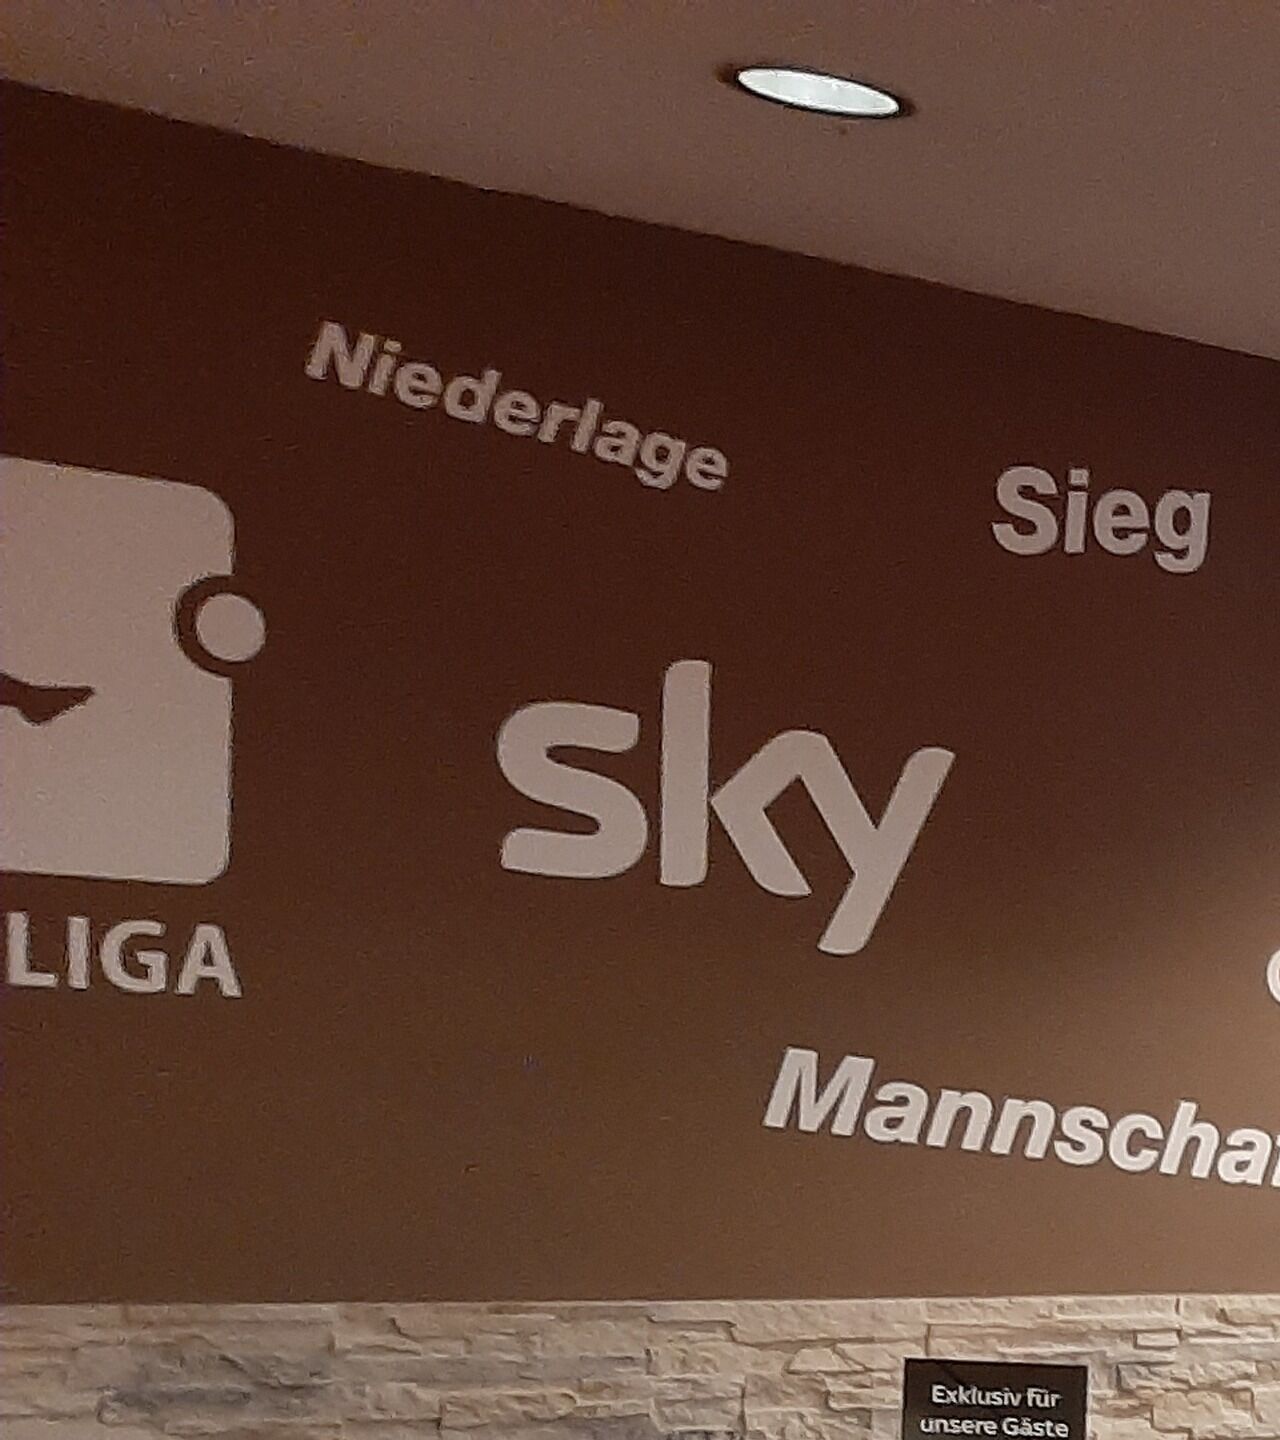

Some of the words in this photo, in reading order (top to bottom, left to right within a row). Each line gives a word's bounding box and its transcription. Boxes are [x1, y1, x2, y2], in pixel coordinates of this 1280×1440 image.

[304, 320, 730, 491] Niederlage
[991, 466, 1212, 574] Sieg
[496, 658, 956, 956] sky
[6, 911, 243, 998] LIGA
[919, 1417, 998, 1436] unsere
[1002, 1416, 1070, 1438] Gäste
[931, 1384, 1022, 1407] Exklusiv
[1026, 1387, 1062, 1408] für
